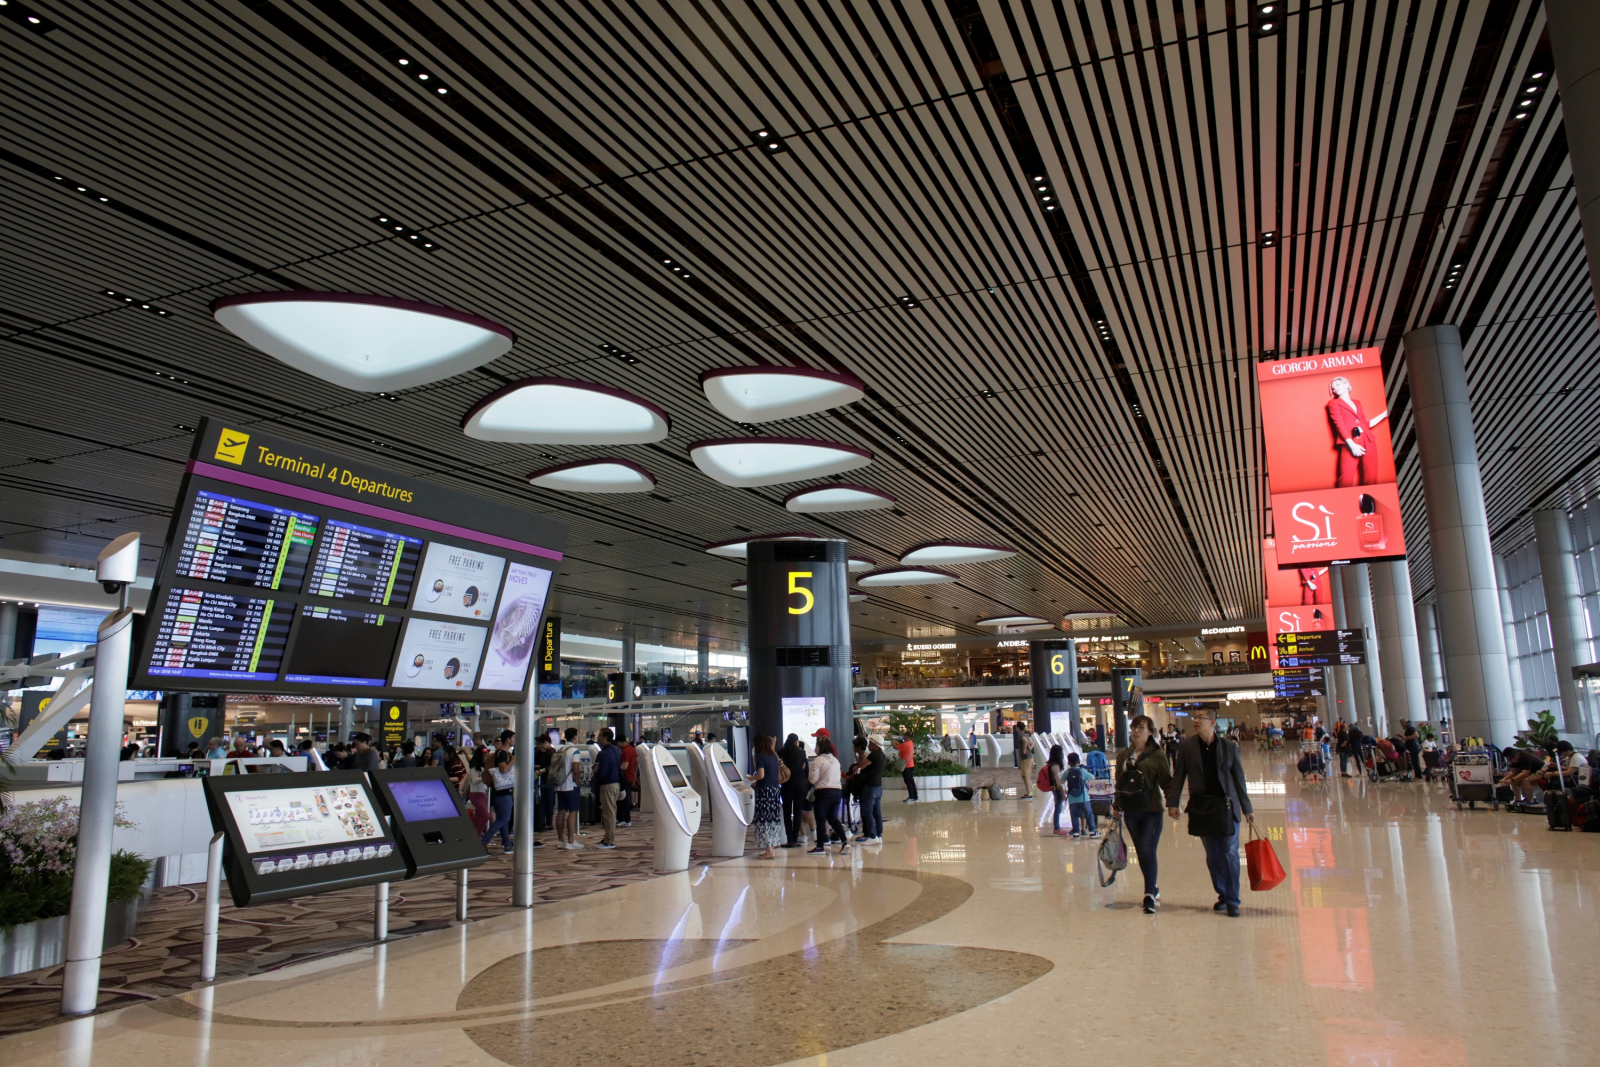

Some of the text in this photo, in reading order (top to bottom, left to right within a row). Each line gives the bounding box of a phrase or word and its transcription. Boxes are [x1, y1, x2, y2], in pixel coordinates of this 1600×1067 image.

[1272, 354, 1363, 375] GIORGIO ARMANI
[258, 446, 414, 503] Terminal 4 Departures
[1292, 502, 1334, 542] Sì
[1292, 540, 1338, 554] passione
[448, 555, 461, 566] FREE
[462, 557, 484, 570] PARKING
[509, 575, 528, 584] MOVES
[787, 571, 814, 615] 5
[429, 629, 465, 642] FREE PARKING
[1202, 626, 1245, 635] McDonald's
[544, 622, 554, 661] Departure
[1051, 654, 1064, 675] 6
[608, 684, 614, 700] 6
[1125, 678, 1134, 692] 7
